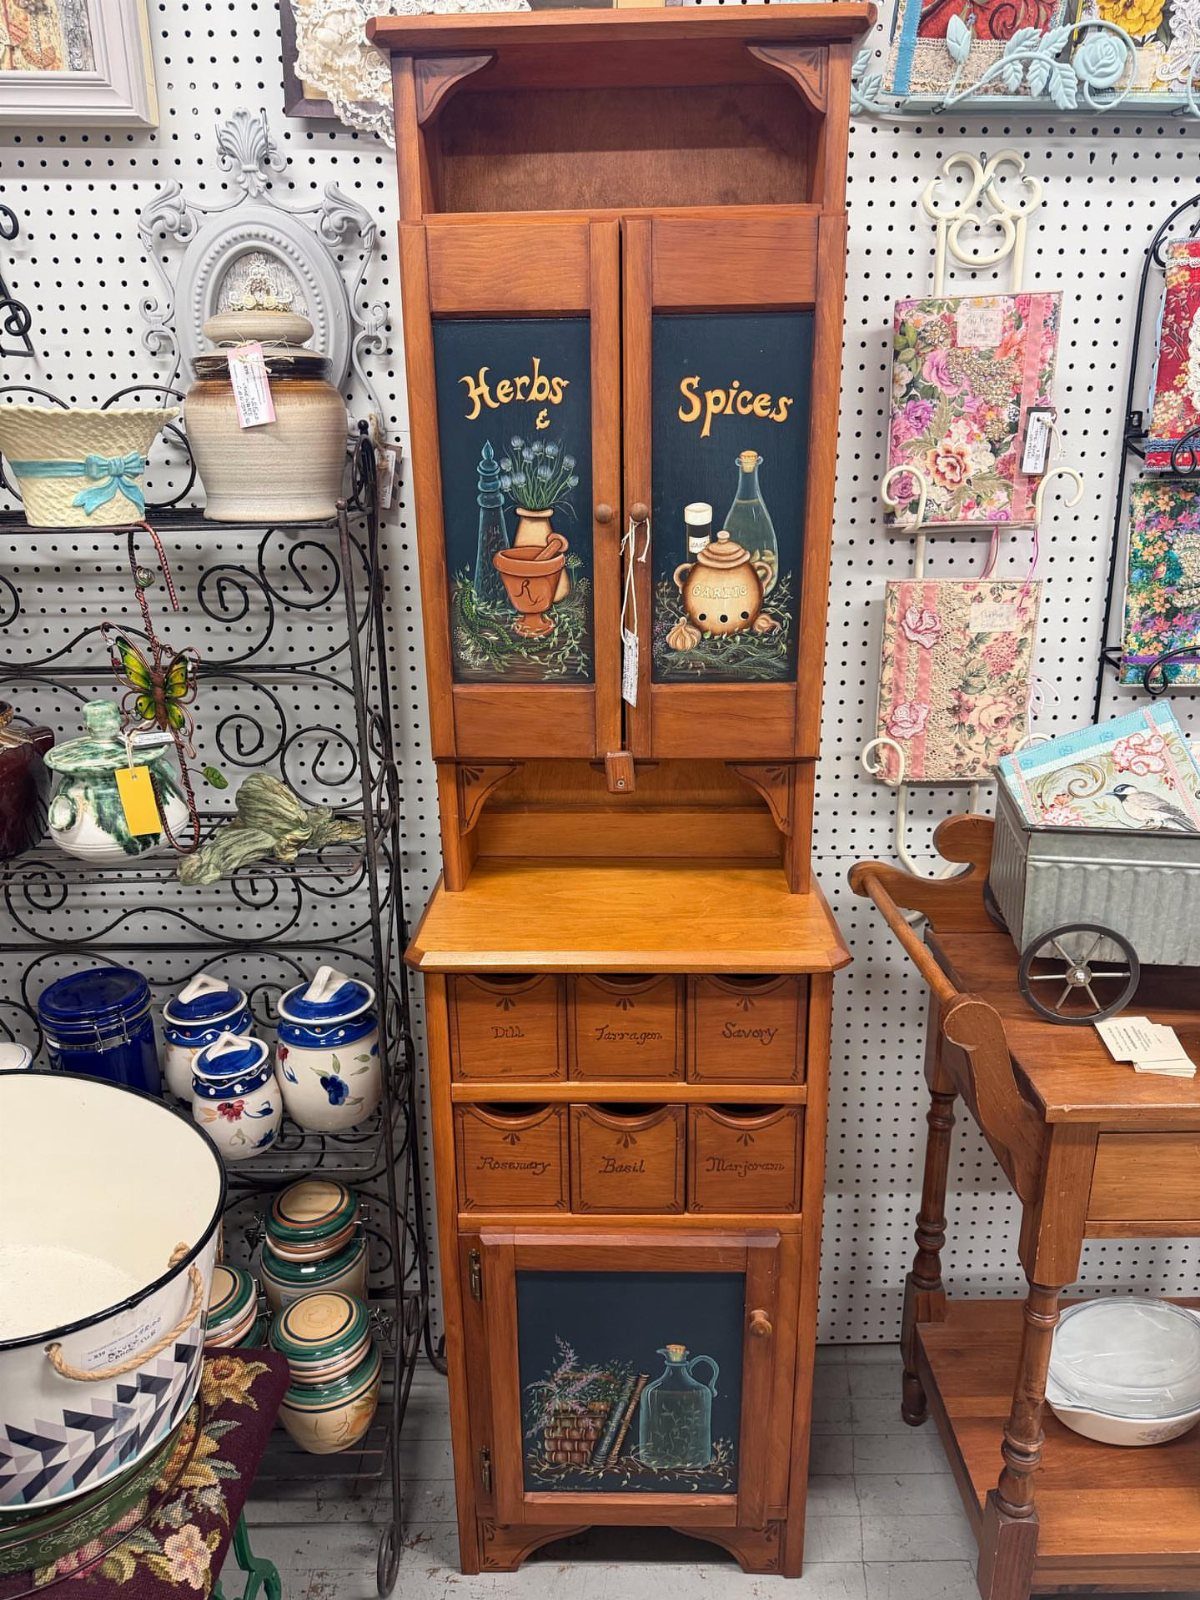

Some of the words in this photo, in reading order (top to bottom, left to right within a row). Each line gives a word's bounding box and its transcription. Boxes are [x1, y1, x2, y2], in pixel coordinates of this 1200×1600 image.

[457, 356, 571, 421] Herbs
[678, 375, 794, 439] Spices
[535, 408, 551, 431] &
[491, 1025, 525, 1039] Dill
[722, 1021, 779, 1046] Savory
[476, 1156, 551, 1176] Rosemary
[598, 1155, 646, 1174] Basil
[705, 1156, 785, 1178] Marjoram
